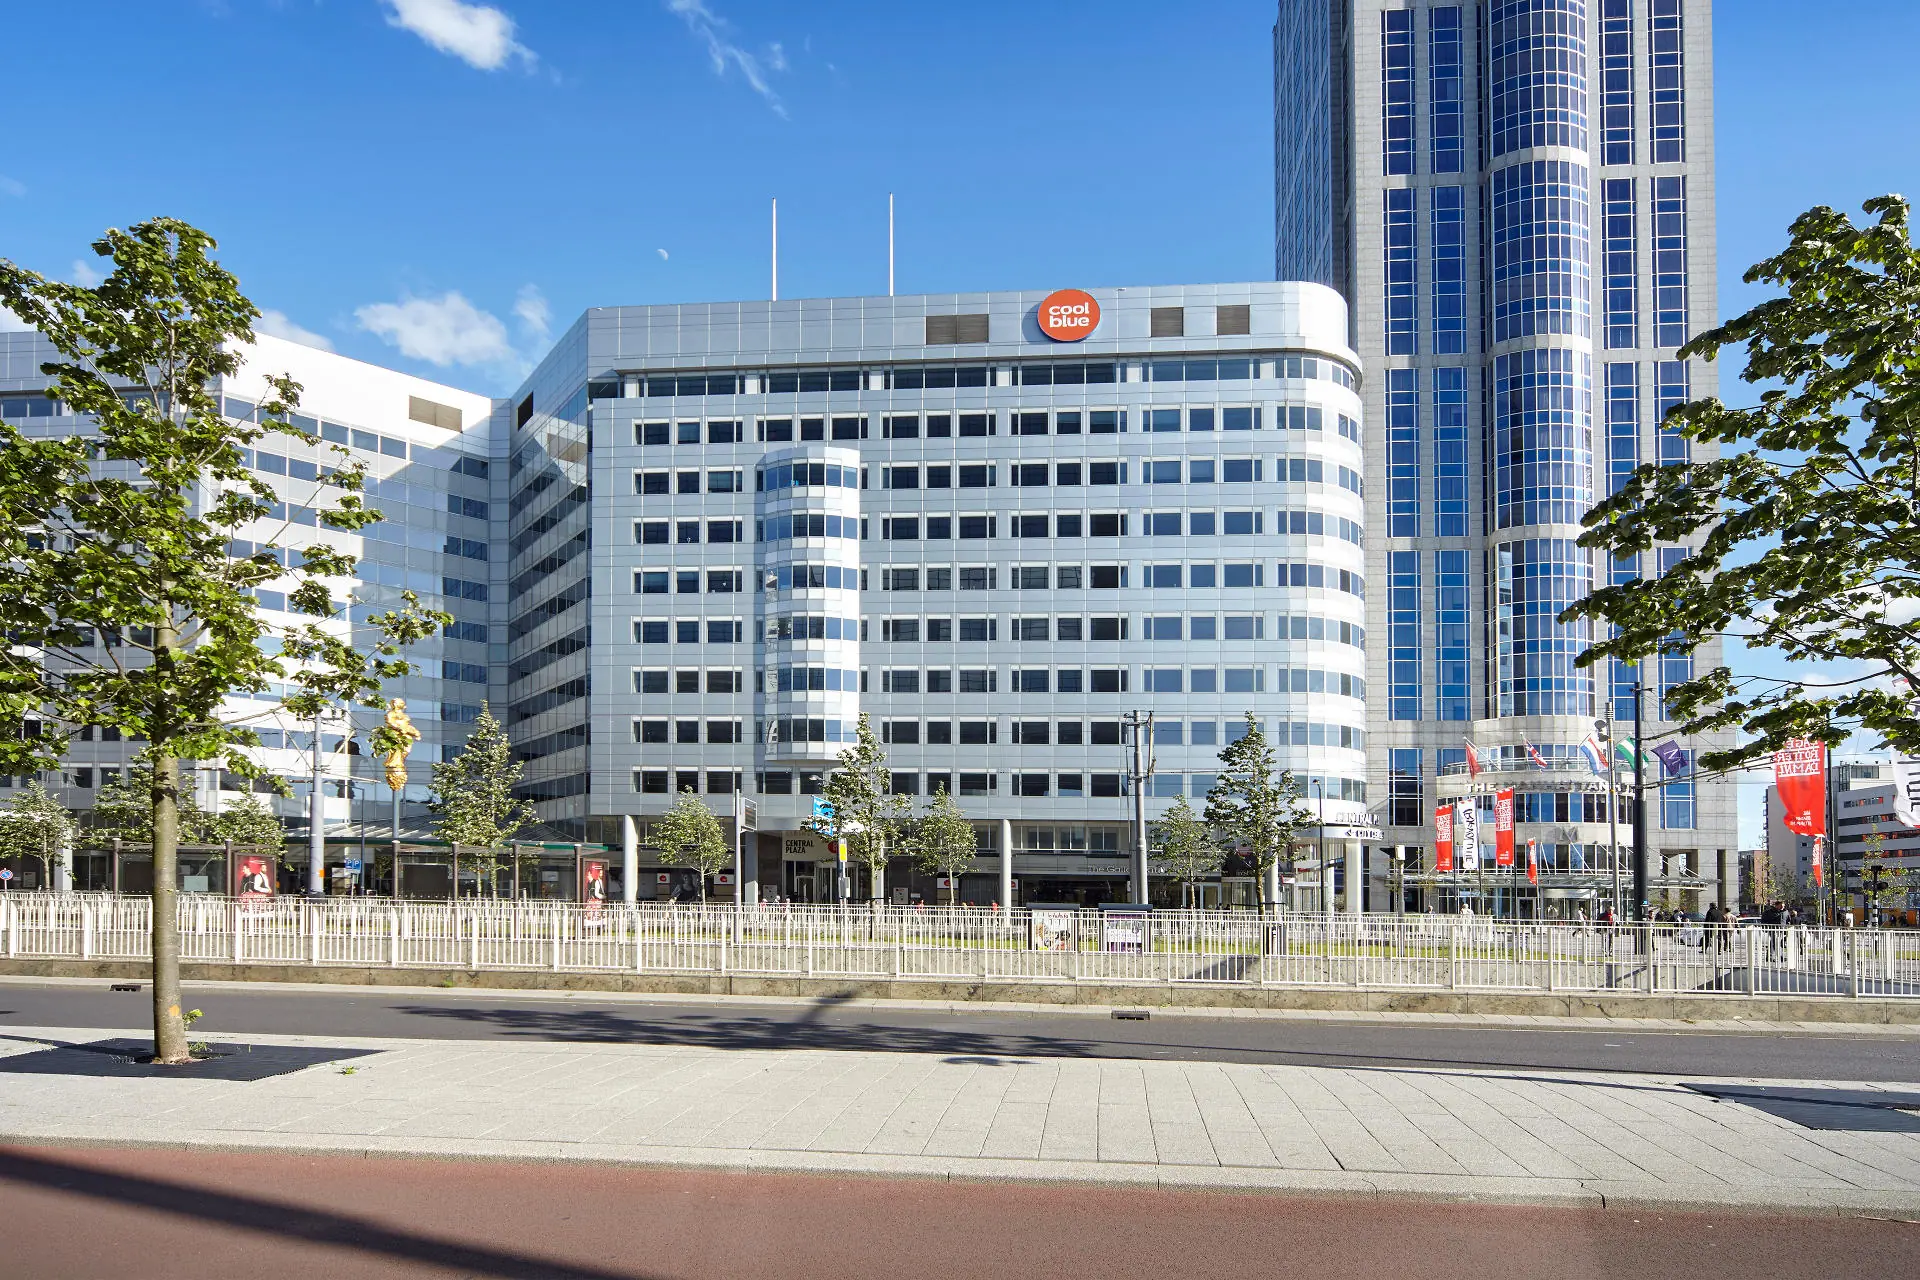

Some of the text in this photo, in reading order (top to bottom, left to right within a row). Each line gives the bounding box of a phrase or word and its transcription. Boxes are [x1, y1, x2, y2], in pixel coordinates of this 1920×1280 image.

[1049, 302, 1089, 315] cool
[1049, 315, 1090, 328] blue
[1465, 783, 1496, 793] THE
